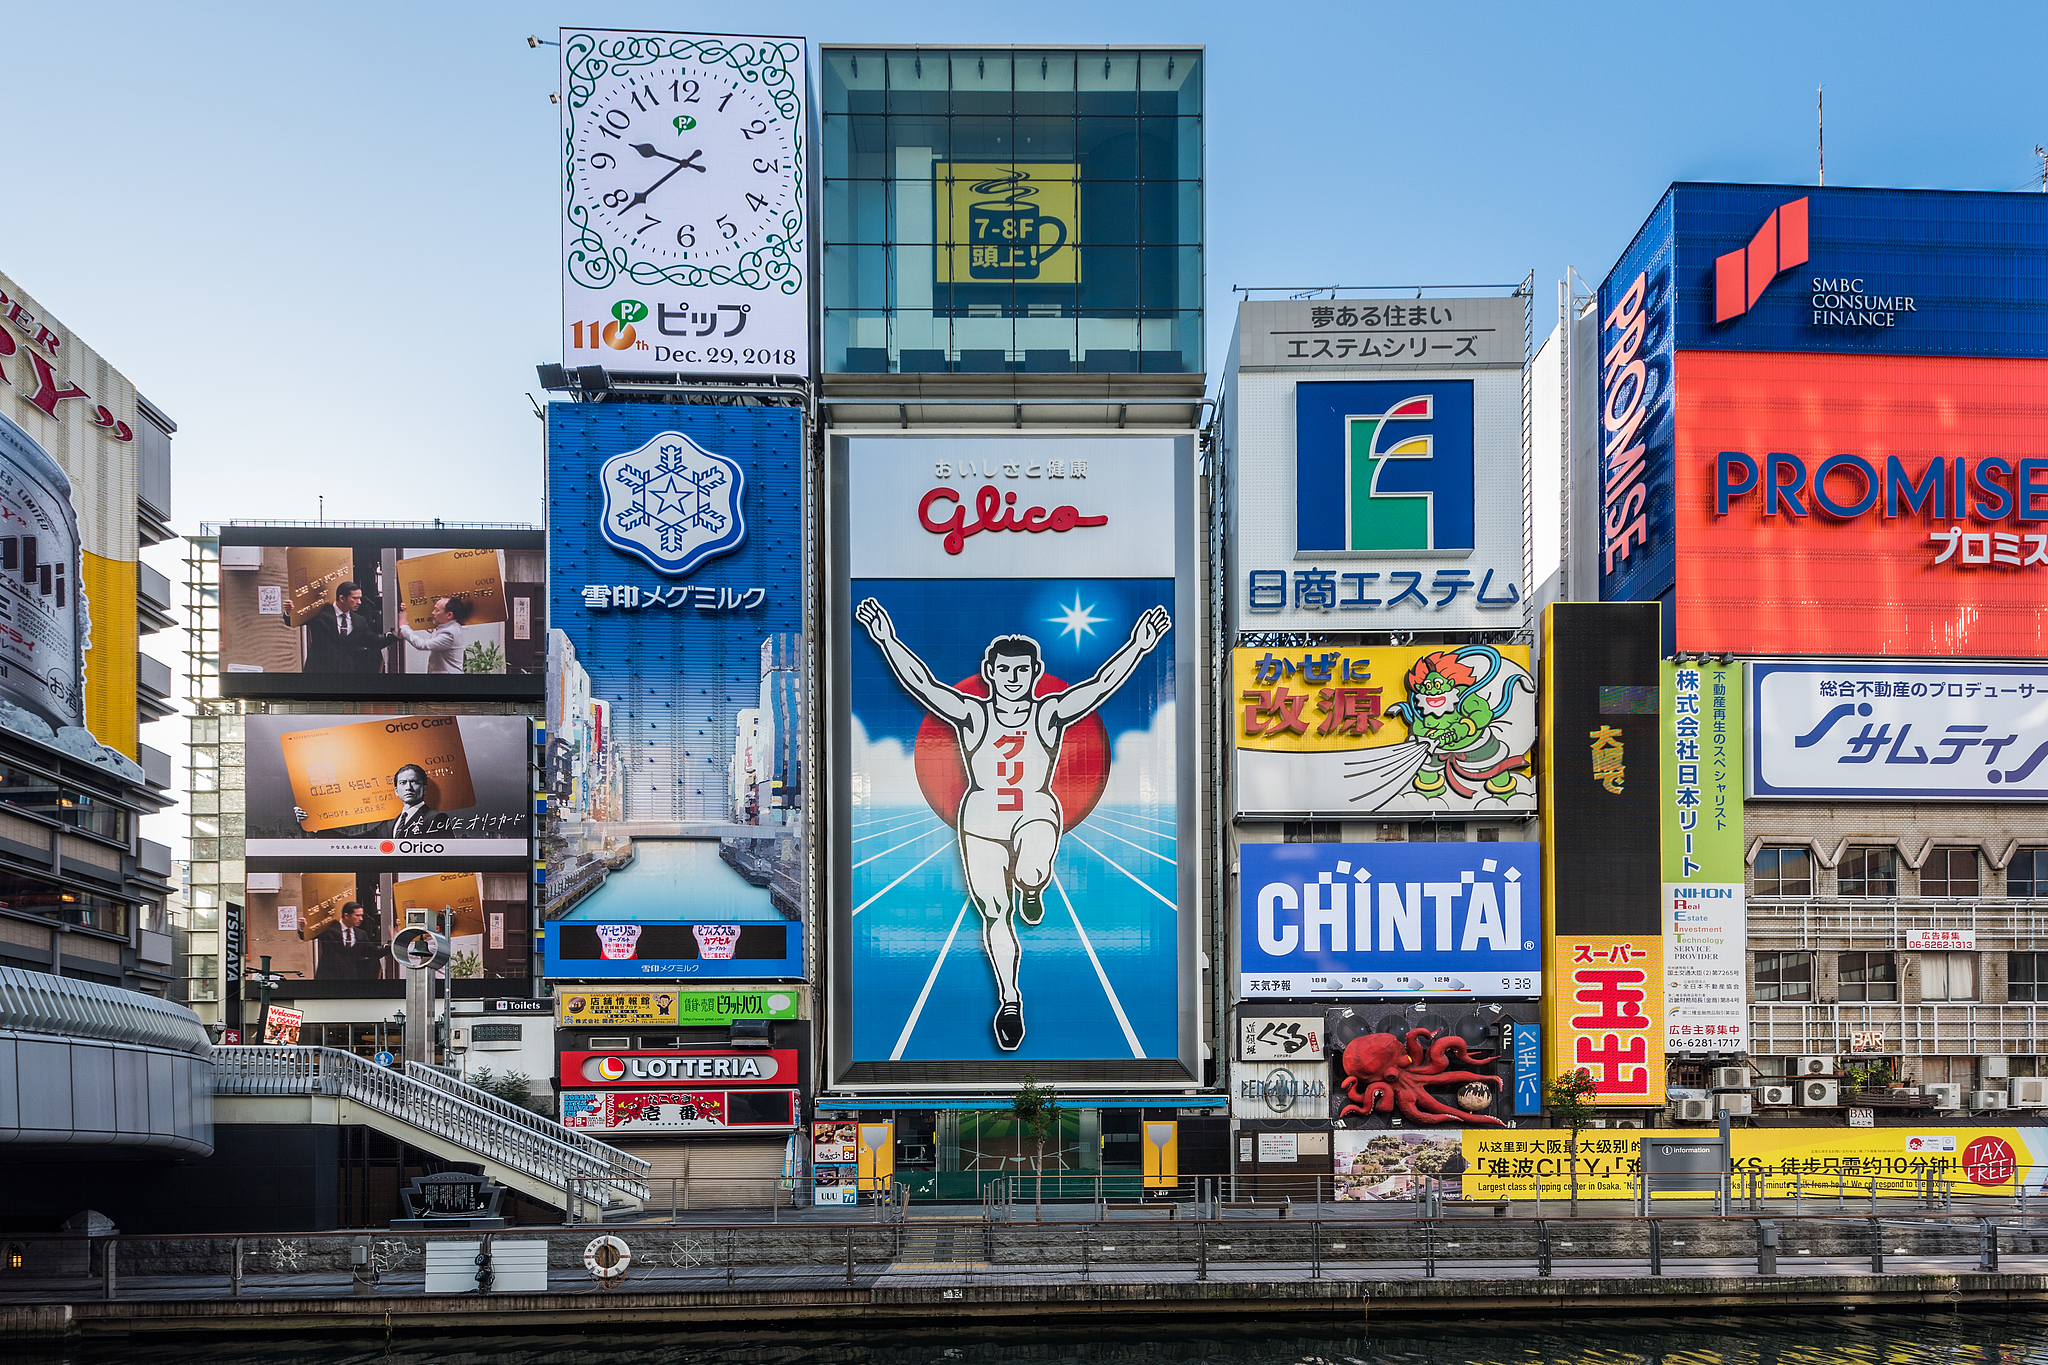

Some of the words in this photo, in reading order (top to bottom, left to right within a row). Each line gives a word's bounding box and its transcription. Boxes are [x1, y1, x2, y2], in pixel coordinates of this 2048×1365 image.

[631, 84, 660, 112] 11
[669, 79, 701, 103] 12
[717, 92, 734, 113] 1
[599, 109, 631, 140] 10
[740, 119, 767, 140] 2
[590, 152, 616, 170] 9
[752, 158, 779, 174] 3
[602, 189, 629, 209] 8
[744, 192, 769, 213] 4
[636, 212, 662, 235] 7
[716, 214, 738, 239] 5
[974, 218, 1034, 239] 7-8F
[676, 224, 696, 248] 6
[1811, 277, 1864, 294] SMBC
[1811, 293, 1917, 313] CONSUMER
[657, 302, 751, 337] ピップ
[1311, 305, 1452, 328] 夢ある住まい
[1811, 310, 1895, 328] FINANCE
[654, 345, 702, 363] Dec.
[707, 347, 739, 366] 29,
[743, 348, 796, 366] 2018
[1287, 336, 1478, 359] エステムシリーズ
[1604, 271, 1648, 577] PROMISE
[935, 458, 1088, 478] おいしさと健康
[1715, 451, 2048, 522] PROMISE
[17, 489, 49, 531] LIMITED
[918, 485, 1108, 555] Glico
[581, 585, 767, 610] 雪印メグミルク
[1250, 567, 1520, 611] 日商エステム
[1255, 652, 1371, 684] かぜに
[1819, 680, 2048, 699] 総合不動産のプロデューサー
[1242, 687, 1385, 736] 改源
[386, 722, 418, 734] Orico
[421, 717, 453, 728] Card
[425, 754, 455, 765] GOLD
[1712, 671, 1727, 831] 不動産再生のスペシャリスト
[993, 731, 1027, 811] グリコ
[1676, 669, 1701, 878] 株式会社日本リート
[310, 784, 341, 796] 0123
[348, 777, 379, 791] 4567
[399, 841, 445, 854] Orico
[1674, 888, 1732, 899] NIHON
[1674, 899, 1700, 910] Real
[1674, 911, 1708, 921] Estate
[1674, 922, 1723, 933] Investment
[1921, 932, 1960, 940] 広告募集
[227, 910, 239, 982] TSUTAYA
[1673, 933, 1724, 945] Technology
[1674, 945, 1711, 953] SERVICE
[1909, 941, 1973, 949] 06-6262-1313
[1574, 943, 1646, 963] スーパー
[641, 964, 699, 973] 雪印メグミルク
[1250, 979, 1291, 992] 天気予報
[269, 1007, 301, 1020] Welcome
[509, 1000, 541, 1010] Toilets
[716, 995, 764, 1015] ピタットハウス
[276, 1017, 300, 1027] OSAKA
[1571, 970, 1650, 1094] 玉出
[1669, 1024, 1740, 1035] 広告主募集中
[227, 1032, 238, 1043] 本
[1669, 1038, 1741, 1048] 06-6281-1717
[1852, 1032, 1882, 1047] BAR
[632, 1058, 760, 1078] LOTTERIA
[1518, 1030, 1537, 1107] ペンギンバー
[648, 1094, 691, 1104] たこやき
[607, 1094, 615, 1127] TAKOYAKI
[1850, 1108, 1873, 1118] BAR
[844, 1152, 854, 1160] 8F
[1969, 1140, 2006, 1163] TAX
[1967, 1158, 2014, 1182] FREE!
[1477, 1182, 1507, 1192] Largest
[1507, 1182, 1527, 1191] class
[1528, 1182, 1562, 1192] shpping
[1588, 1182, 1595, 1190] in
[1597, 1182, 1622, 1192] Osaka,
[1851, 1180, 1862, 1188] We
[1906, 1180, 1912, 1188] to
[844, 1194, 854, 1203] 7F
